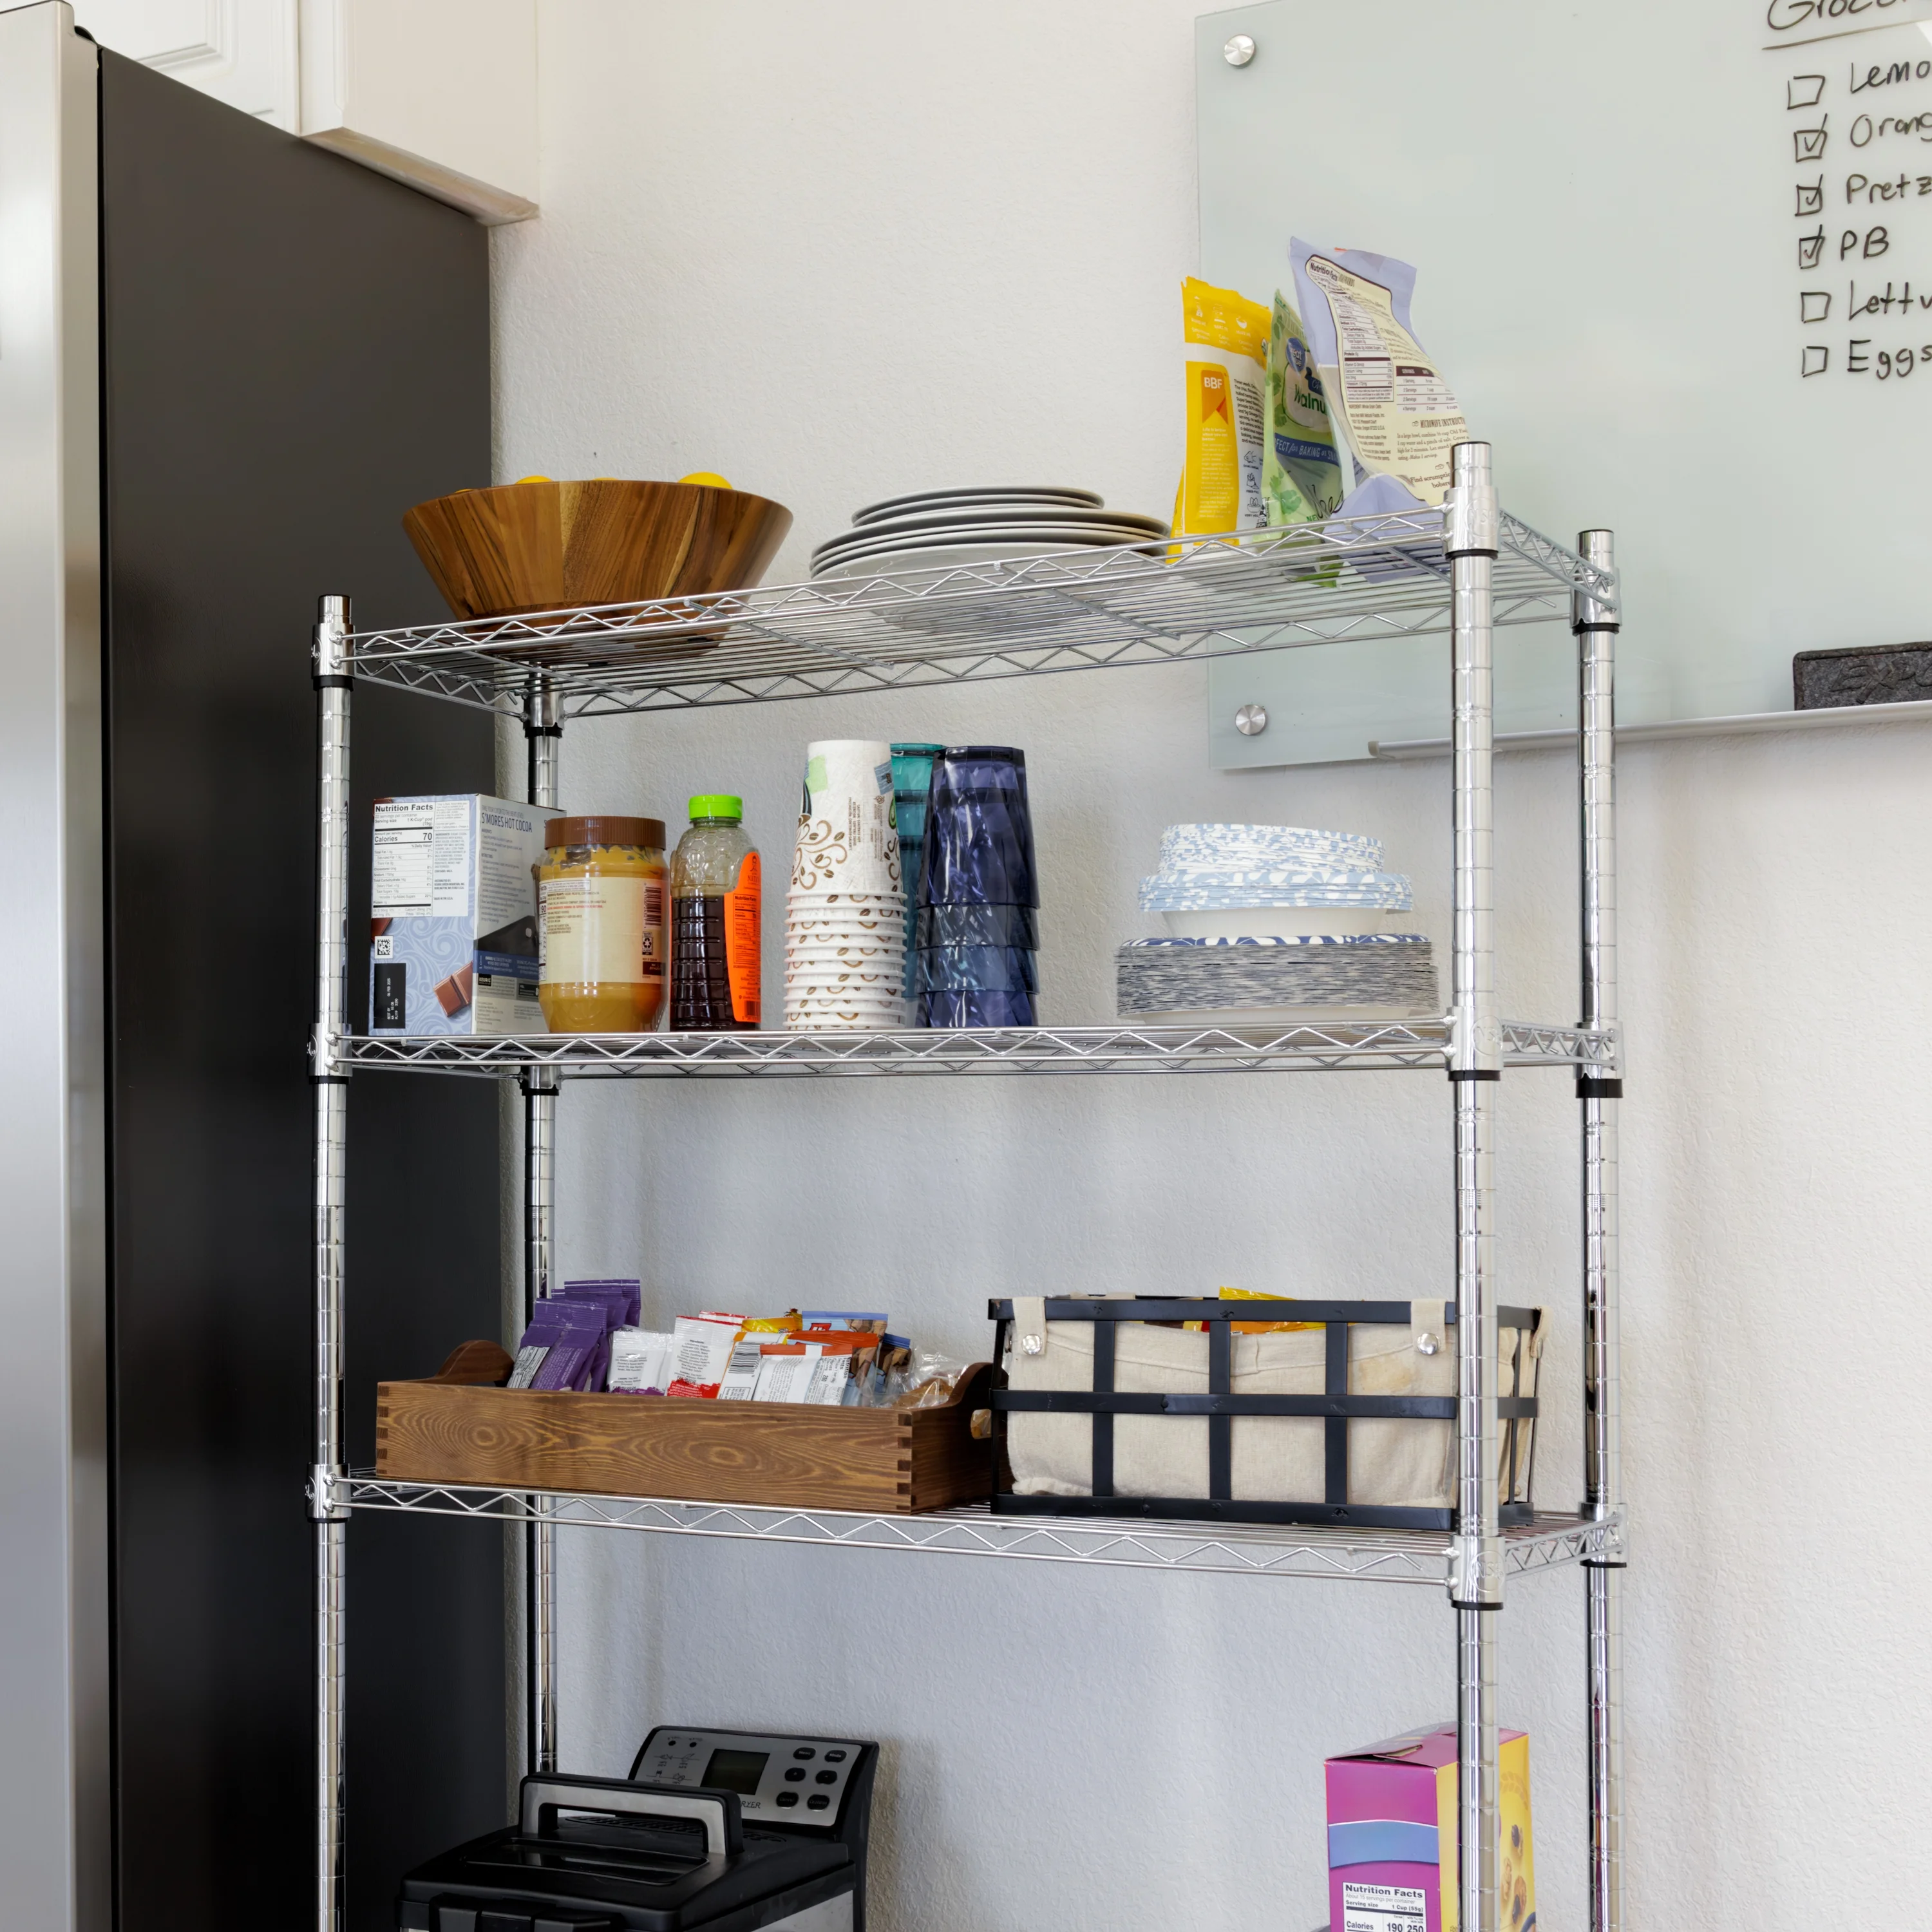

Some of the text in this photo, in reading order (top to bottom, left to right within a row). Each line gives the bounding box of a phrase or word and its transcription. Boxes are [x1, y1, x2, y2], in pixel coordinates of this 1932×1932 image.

[1850, 61, 1932, 94] Lemo
[1846, 173, 1932, 205] Pretz
[1840, 225, 1889, 261] PB
[1203, 376, 1223, 389] BBF
[1274, 438, 1289, 452] FECT
[1298, 445, 1321, 458] BAKING
[481, 812, 504, 828] S'MORES
[504, 817, 515, 830] HOT
[515, 819, 533, 833] COCOA
[422, 832, 433, 841] 70
[740, 1800, 761, 1809] RYER
[1345, 1884, 1423, 1899] Nutrition Facts
[1346, 1920, 1374, 1931] Calories
[1387, 1922, 1403, 1932] 190
